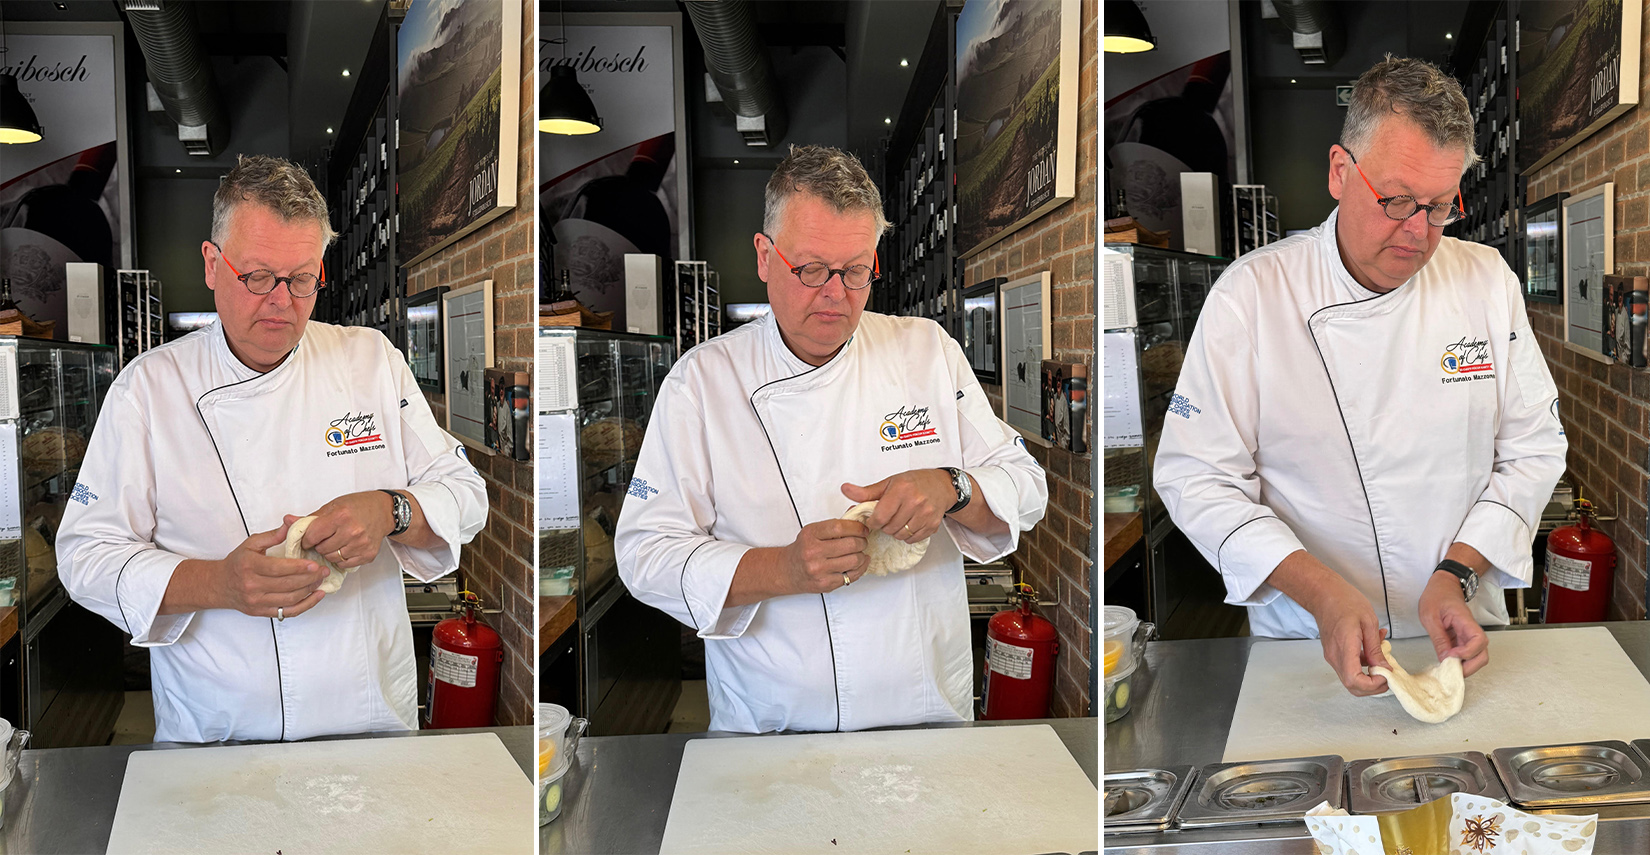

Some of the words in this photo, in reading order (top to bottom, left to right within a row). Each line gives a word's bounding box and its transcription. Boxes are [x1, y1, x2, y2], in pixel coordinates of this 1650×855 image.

[1589, 54, 1620, 116] JORDAN
[1026, 149, 1057, 207] JORDAN
[468, 159, 498, 216] JORDAN
[1446, 336, 1488, 352] Academy
[1459, 350, 1466, 365] of
[1466, 345, 1489, 364] Chefs
[1441, 376, 1472, 384] Fortunato
[330, 411, 375, 427] Academy
[884, 405, 929, 421] Academy
[344, 423, 352, 438] of
[352, 420, 376, 437] Chefs
[899, 418, 907, 433] of
[906, 413, 931, 431] Chefs
[326, 448, 359, 457] Fortunato
[359, 444, 386, 452] Mazzone
[881, 442, 914, 452] Fortunato
[914, 438, 941, 446] Mazzone
